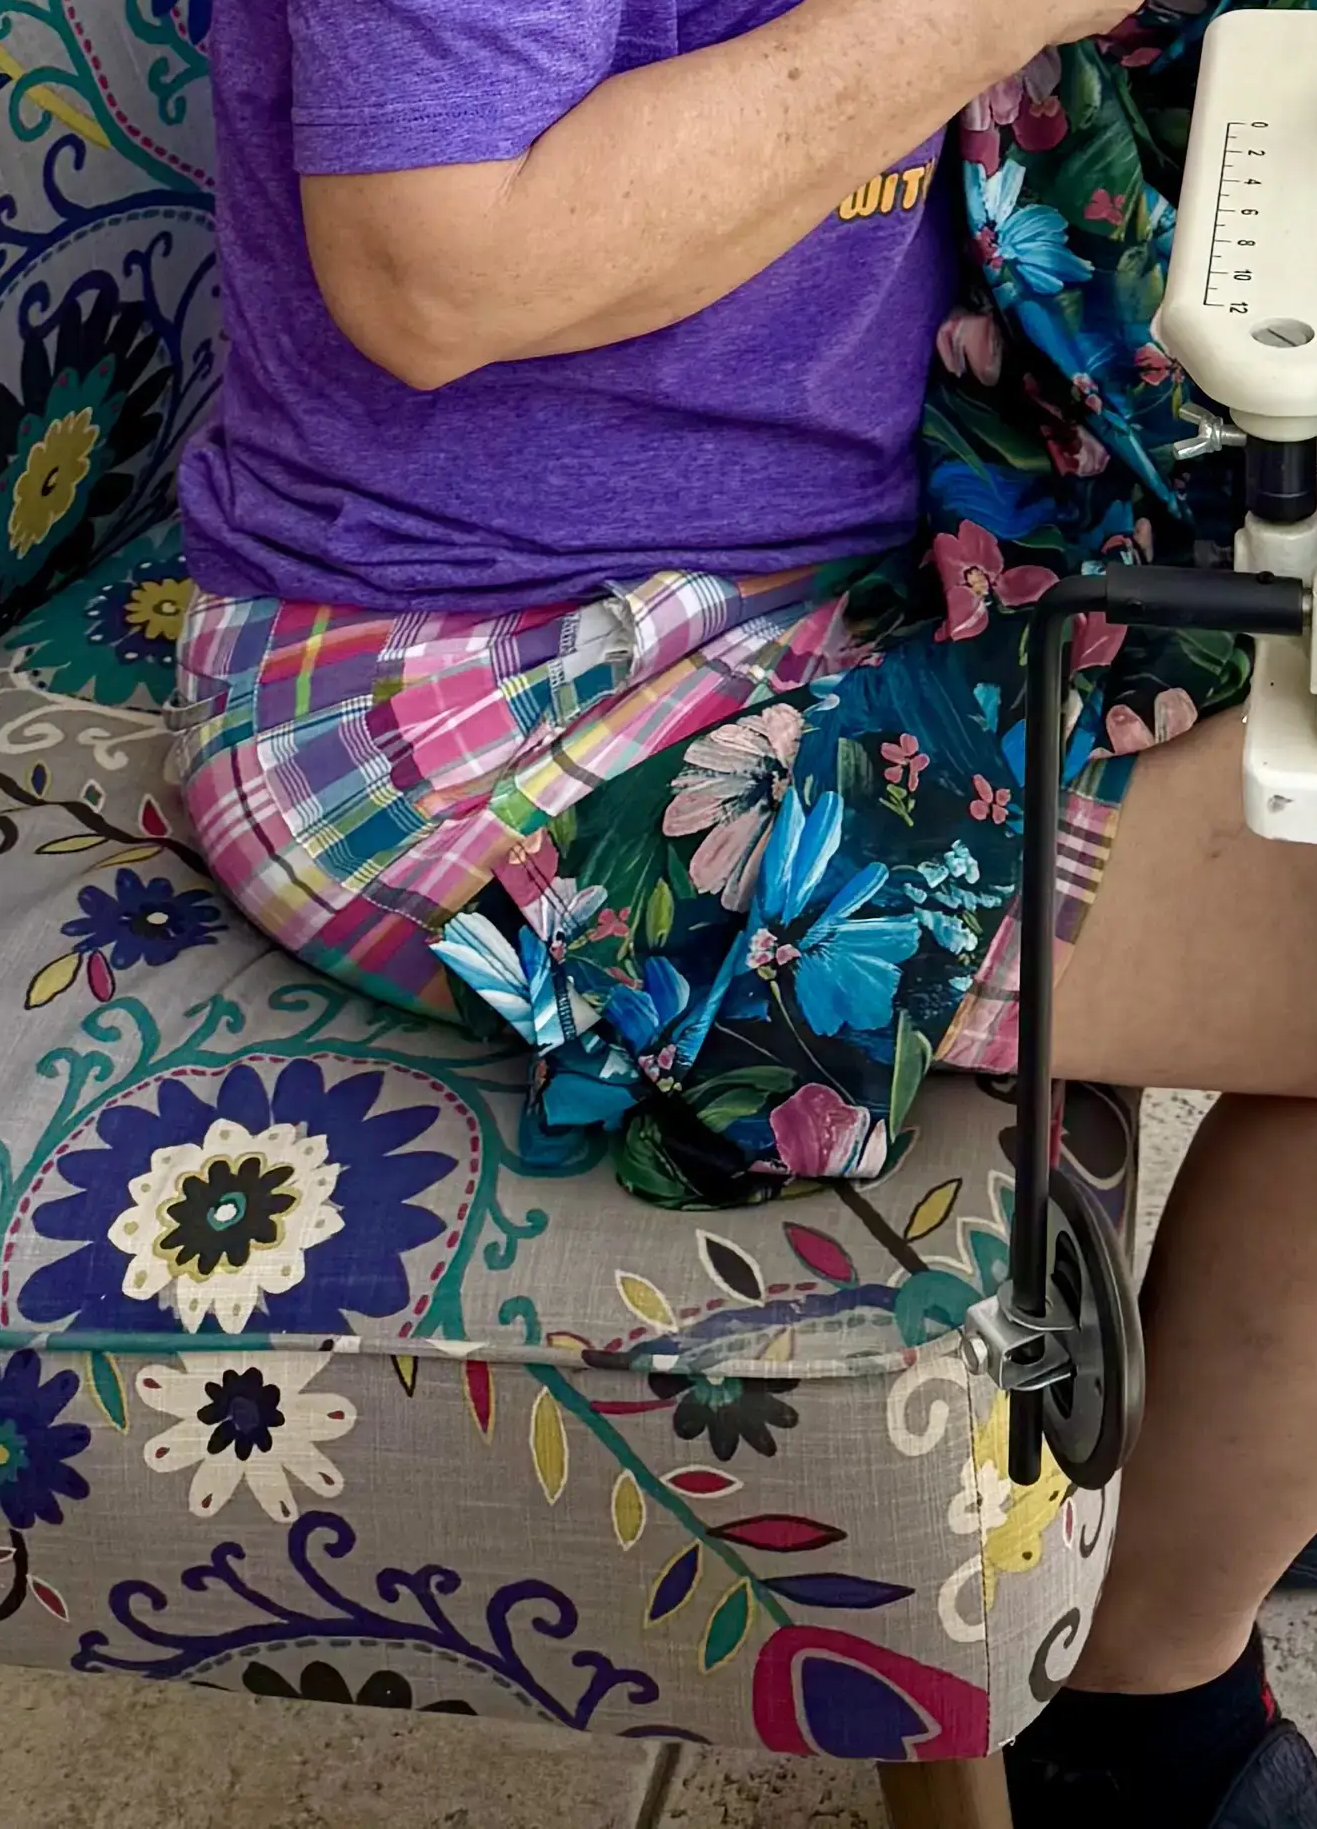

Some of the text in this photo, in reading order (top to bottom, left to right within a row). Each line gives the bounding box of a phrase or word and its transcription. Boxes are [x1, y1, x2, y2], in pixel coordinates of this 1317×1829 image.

[1248, 149, 1266, 157] 2
[838, 156, 936, 220] WIT
[1241, 208, 1259, 216] 6
[1237, 239, 1256, 247] 8
[1233, 269, 1253, 281] 10
[1229, 301, 1249, 314] 12
